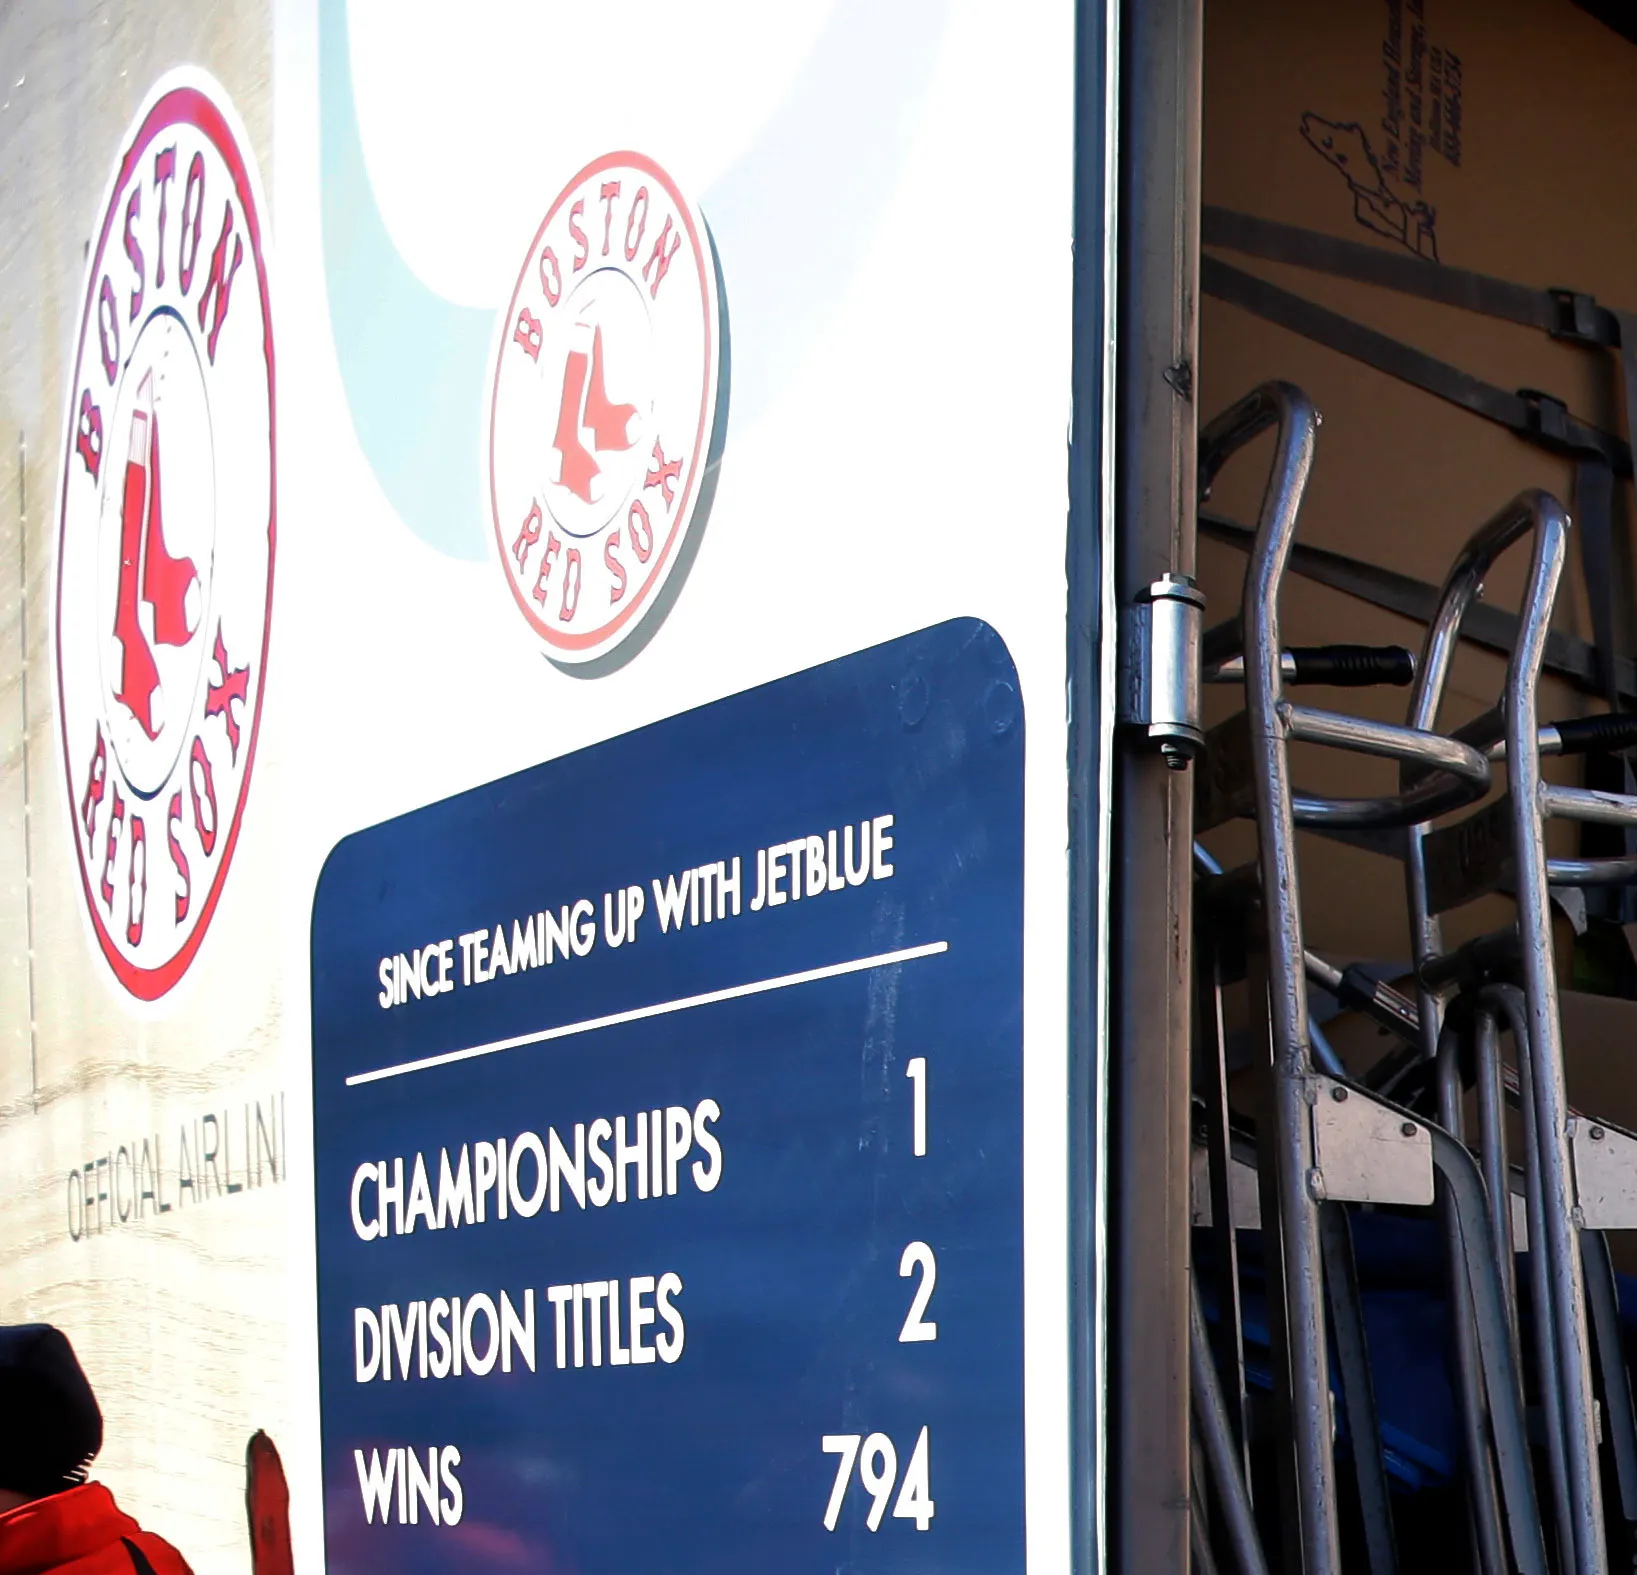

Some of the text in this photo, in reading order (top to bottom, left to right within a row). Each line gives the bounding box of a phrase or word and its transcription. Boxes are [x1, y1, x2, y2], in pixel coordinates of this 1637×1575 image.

[76, 146, 243, 487] BOSTON
[513, 181, 680, 363] BOSTON
[512, 436, 684, 622] RED SOX
[82, 616, 250, 947] RED SOX
[378, 814, 894, 1009] SINCE TEAMING UP WITH JETBLUE
[67, 1091, 287, 1243] OFFICIAL AIRLIN
[350, 1056, 927, 1242] CHAMPIONSHIPS 1
[354, 1240, 938, 1384] DIVISION TITLES 2
[353, 1425, 935, 1533] WINS 794
